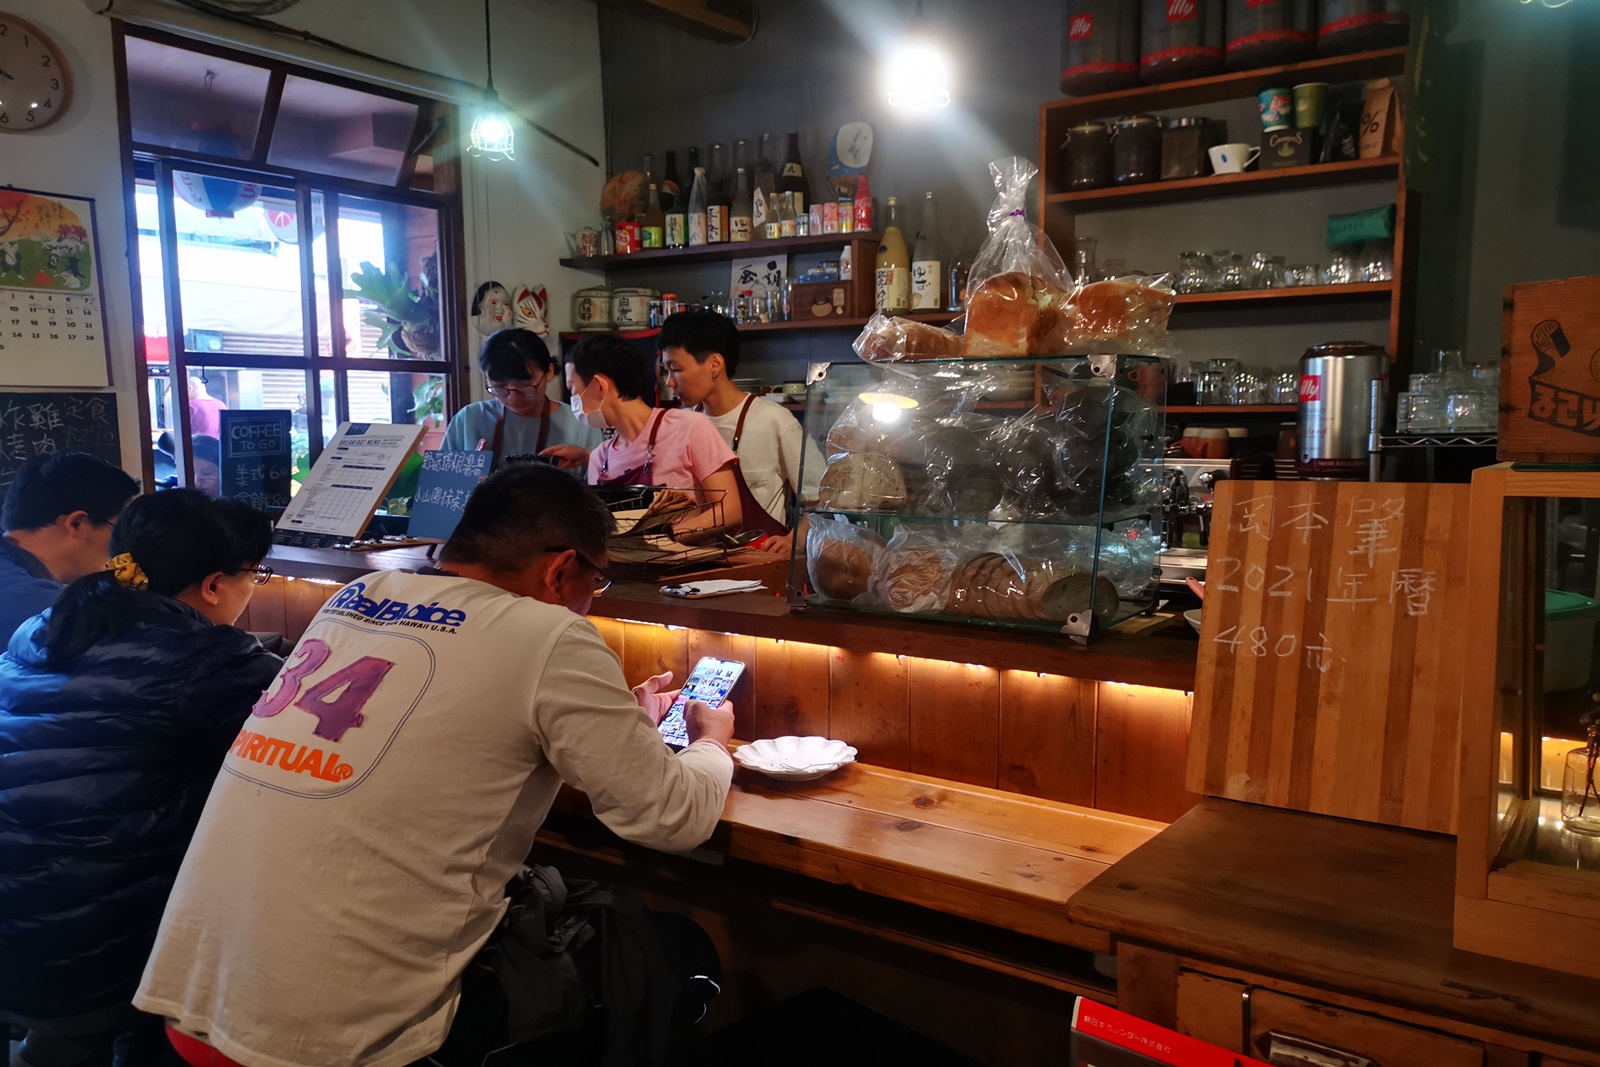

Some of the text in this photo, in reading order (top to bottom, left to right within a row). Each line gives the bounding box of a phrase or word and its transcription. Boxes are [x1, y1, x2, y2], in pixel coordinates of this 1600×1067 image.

[1070, 18, 1091, 36] illy
[24, 35, 29, 47] 1
[42, 55, 51, 67] 2
[51, 78, 59, 90] 3
[43, 98, 52, 109] 4
[0, 112, 9, 123] 6
[26, 110, 35, 122] 5
[1301, 379, 1319, 399] illy
[231, 423, 281, 440] COFFEE
[240, 439, 276, 450] TO GO
[235, 463, 288, 487] 美式 60
[400, 620, 429, 630] HAWAII
[430, 625, 458, 635] U.S.A.
[252, 638, 395, 743] 34
[1083, 1015, 1171, 1054] 新日本カレンダー株式会社
